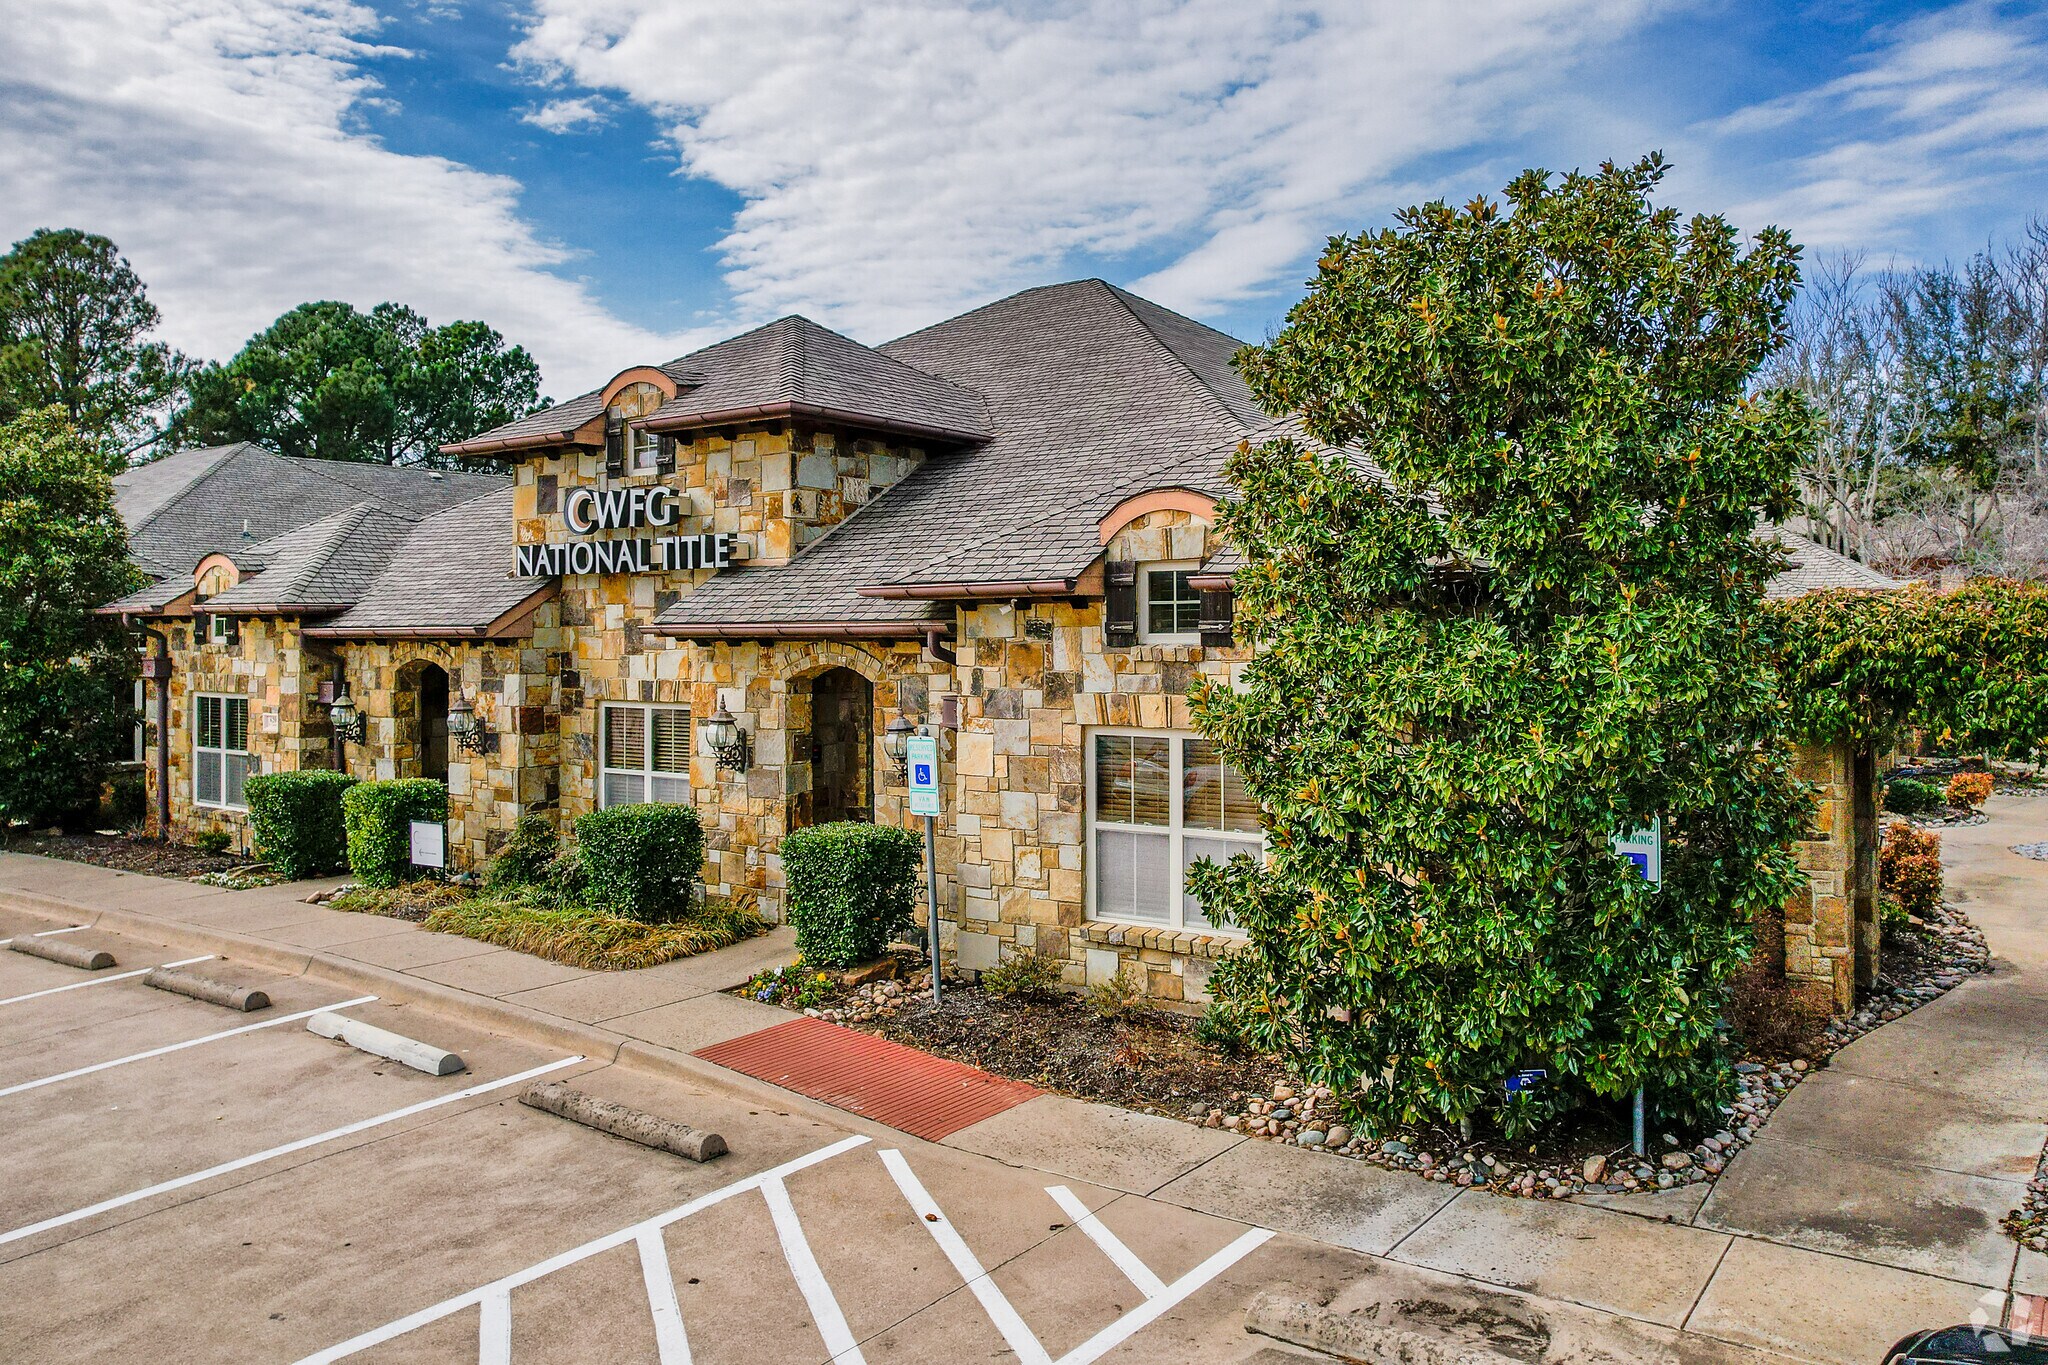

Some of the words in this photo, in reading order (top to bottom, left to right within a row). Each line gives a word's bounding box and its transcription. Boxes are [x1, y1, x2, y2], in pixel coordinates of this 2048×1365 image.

[564, 486, 671, 535] CWFG
[516, 539, 650, 577] NATIONAL
[656, 533, 729, 571] TITLE
[1615, 834, 1654, 846] PAKING
